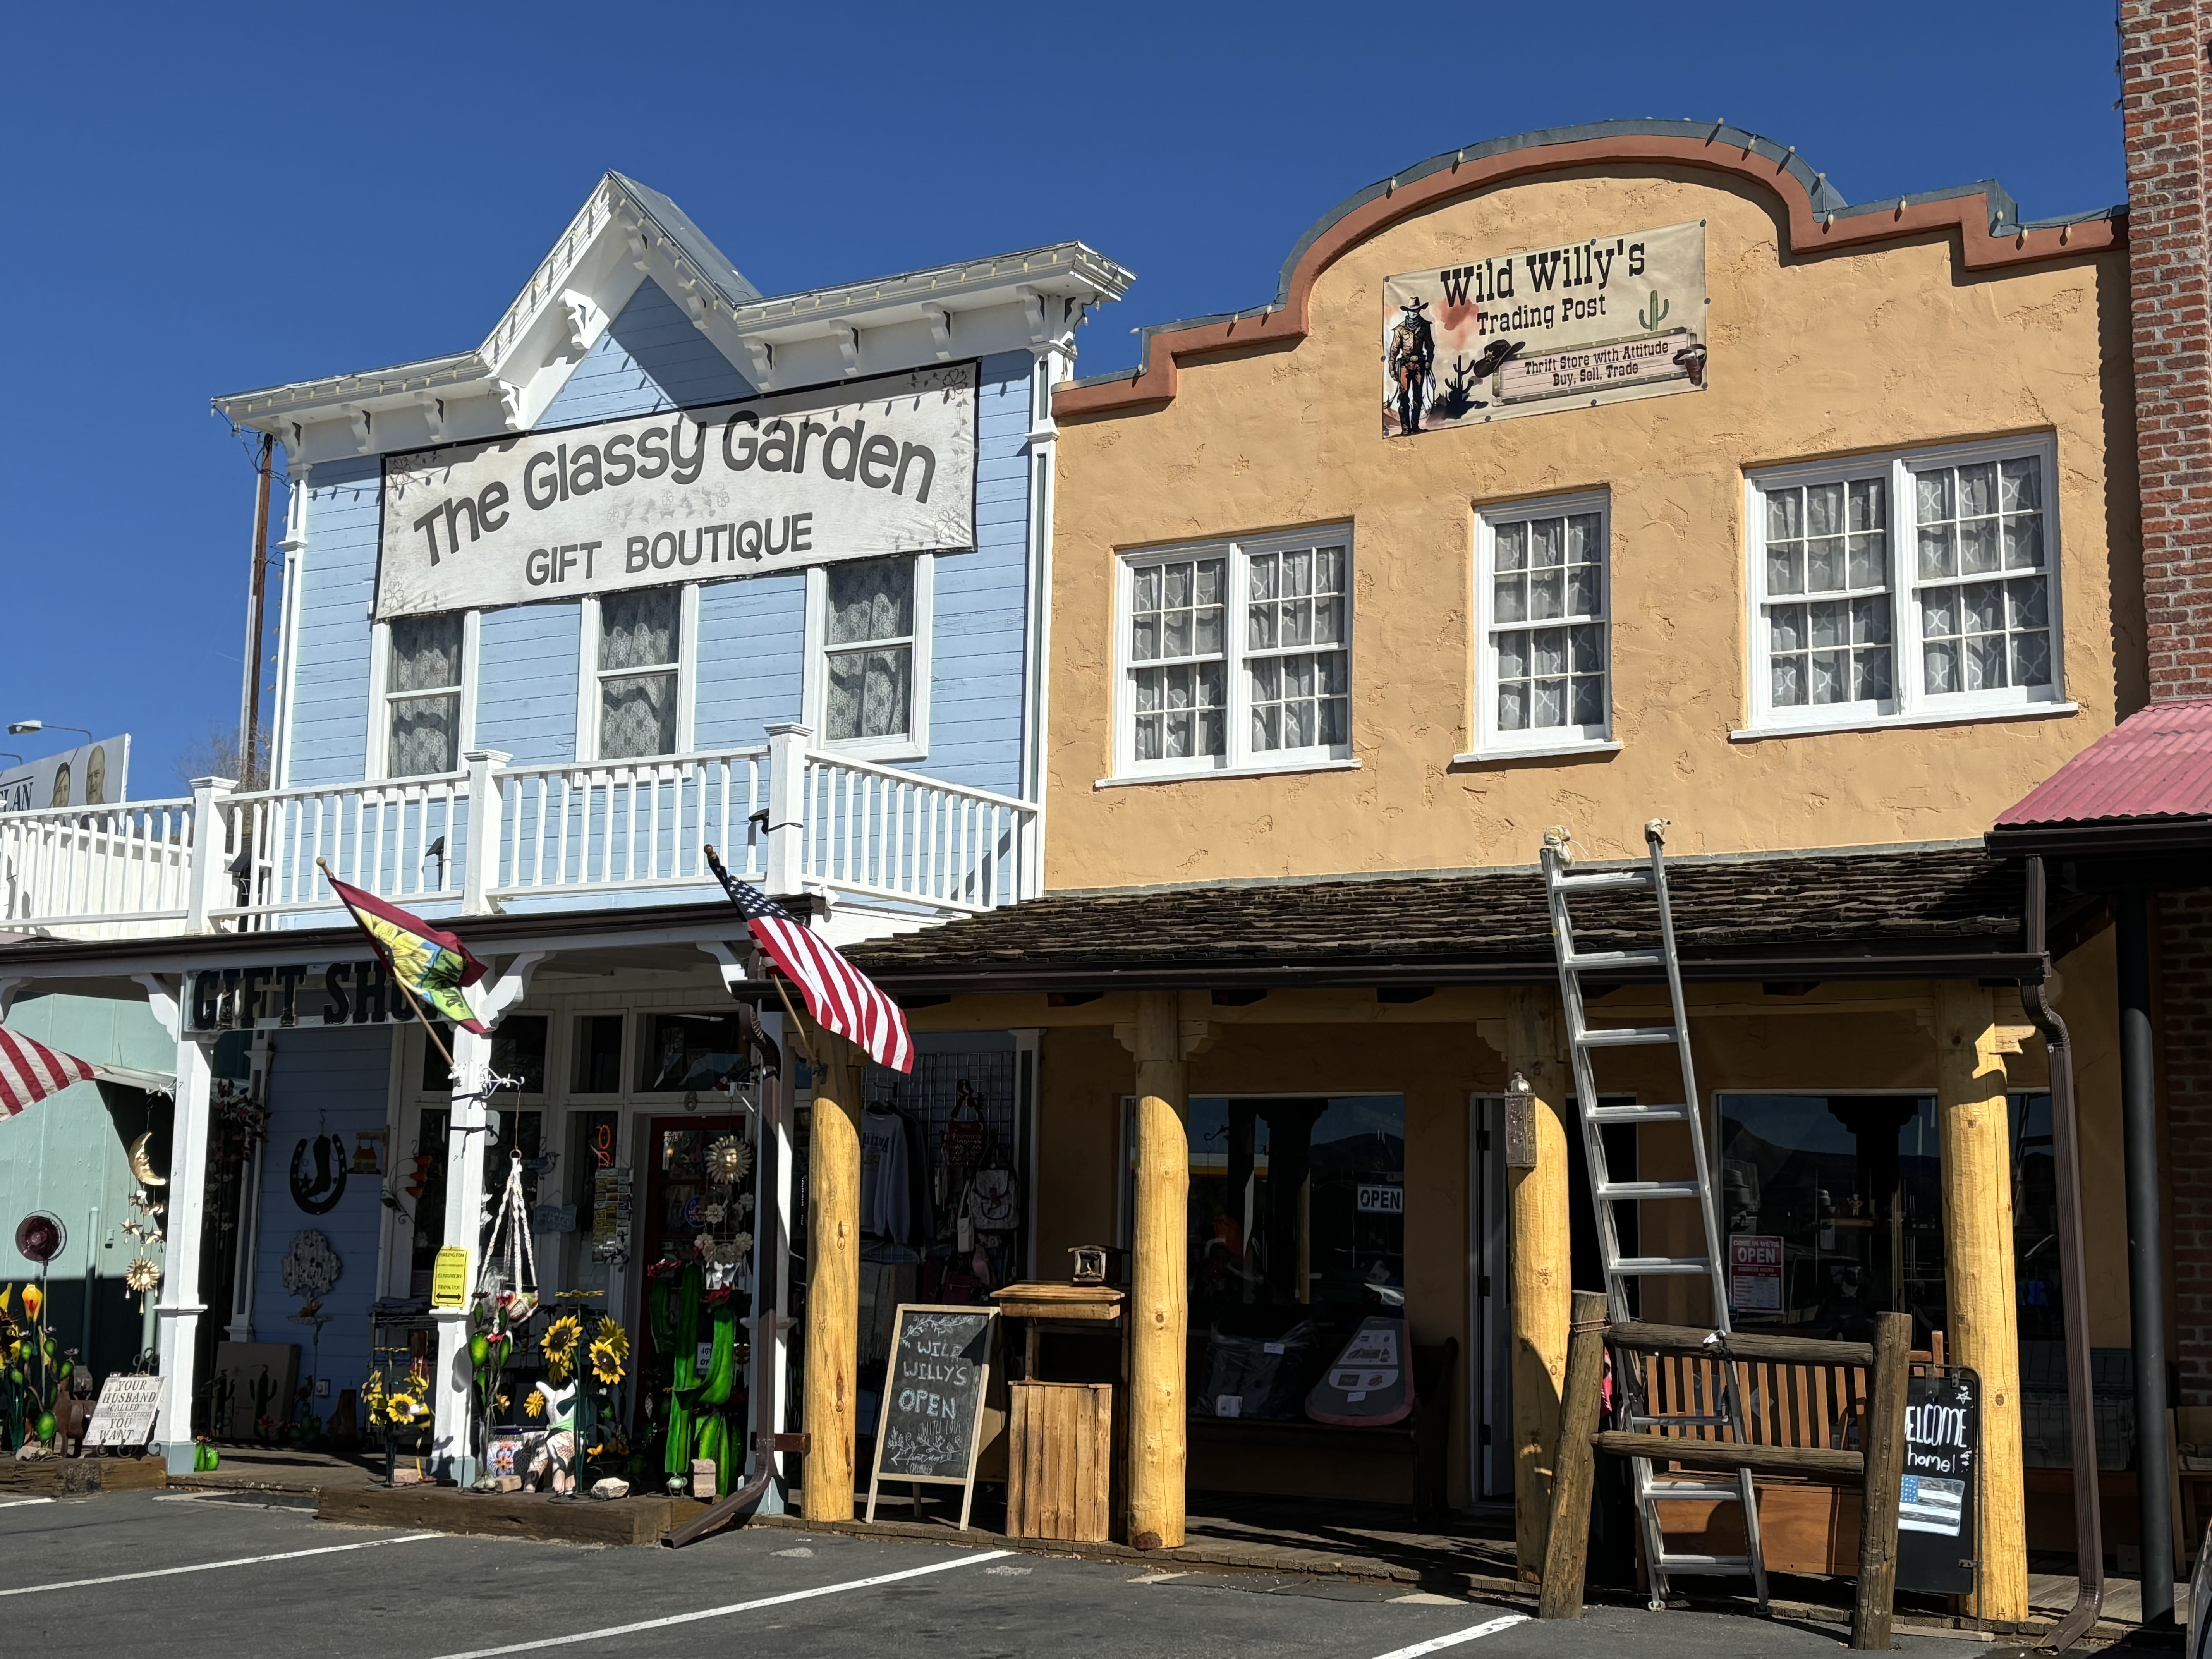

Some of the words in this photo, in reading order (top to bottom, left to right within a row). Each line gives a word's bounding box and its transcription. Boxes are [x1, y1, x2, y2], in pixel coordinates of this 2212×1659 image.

[1441, 258, 1514, 308] Wild
[1526, 239, 1645, 293] Willy's
[1477, 304, 1554, 336] Trading
[1561, 294, 1606, 322] Post
[1525, 357, 1556, 374] Thrift
[1560, 354, 1590, 369] Store
[1593, 348, 1620, 364] with
[1623, 340, 1669, 360] Attitude
[1553, 373, 1577, 386] Buy,
[1580, 367, 1602, 382] Sell,
[1606, 361, 1639, 378] Trade
[413, 481, 510, 567] The
[524, 421, 707, 511] Glassy
[723, 410, 936, 504] Garden
[526, 541, 602, 586] GIFT
[625, 512, 813, 574] BOUTIQUE
[0, 782, 34, 812] LAN
[194, 966, 307, 1030] GIFT
[323, 961, 440, 1025] SHO
[684, 1091, 697, 1111] 6
[1360, 1189, 1401, 1209] OPEN
[1738, 1247, 1776, 1263] OPEN
[918, 1339, 963, 1358] WILD
[117, 1380, 147, 1391] YOUR
[903, 1361, 967, 1386] WILLY'S
[103, 1392, 156, 1403] HUSBAND
[898, 1388, 956, 1420] OPEN
[100, 1429, 134, 1440] WANT
[110, 1417, 132, 1429] YOU
[1908, 1444, 1956, 1473] home!
